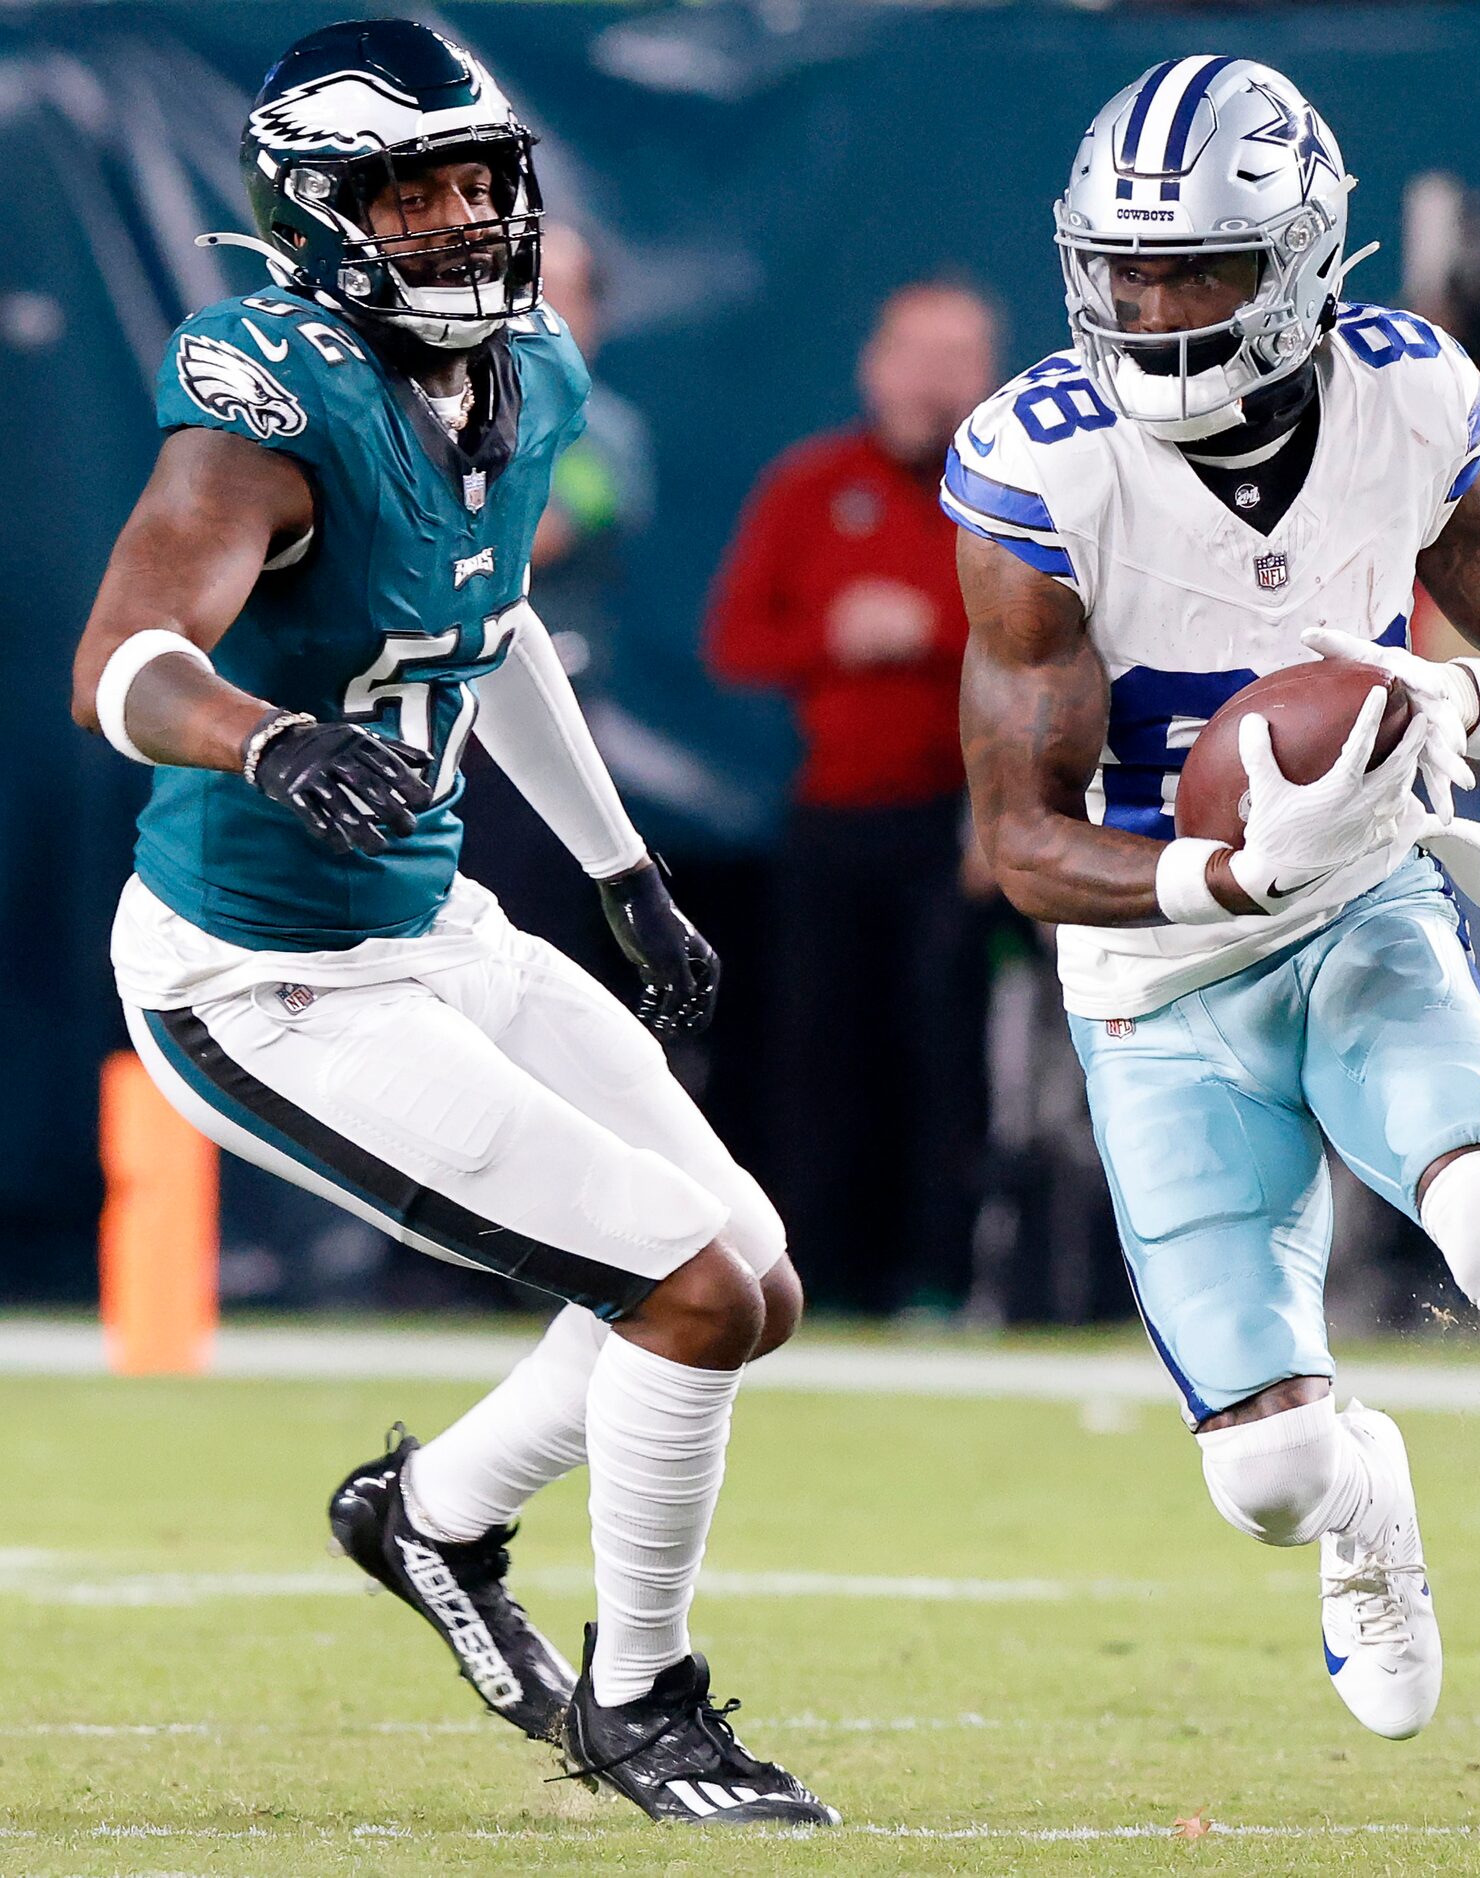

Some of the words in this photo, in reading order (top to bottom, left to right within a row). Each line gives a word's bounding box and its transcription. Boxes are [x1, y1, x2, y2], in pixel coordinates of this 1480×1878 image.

[1117, 208, 1174, 221] COWBOYS
[1261, 568, 1285, 586] NFL
[286, 989, 311, 1010] NFL
[394, 1534, 524, 1709] ADIZERO
